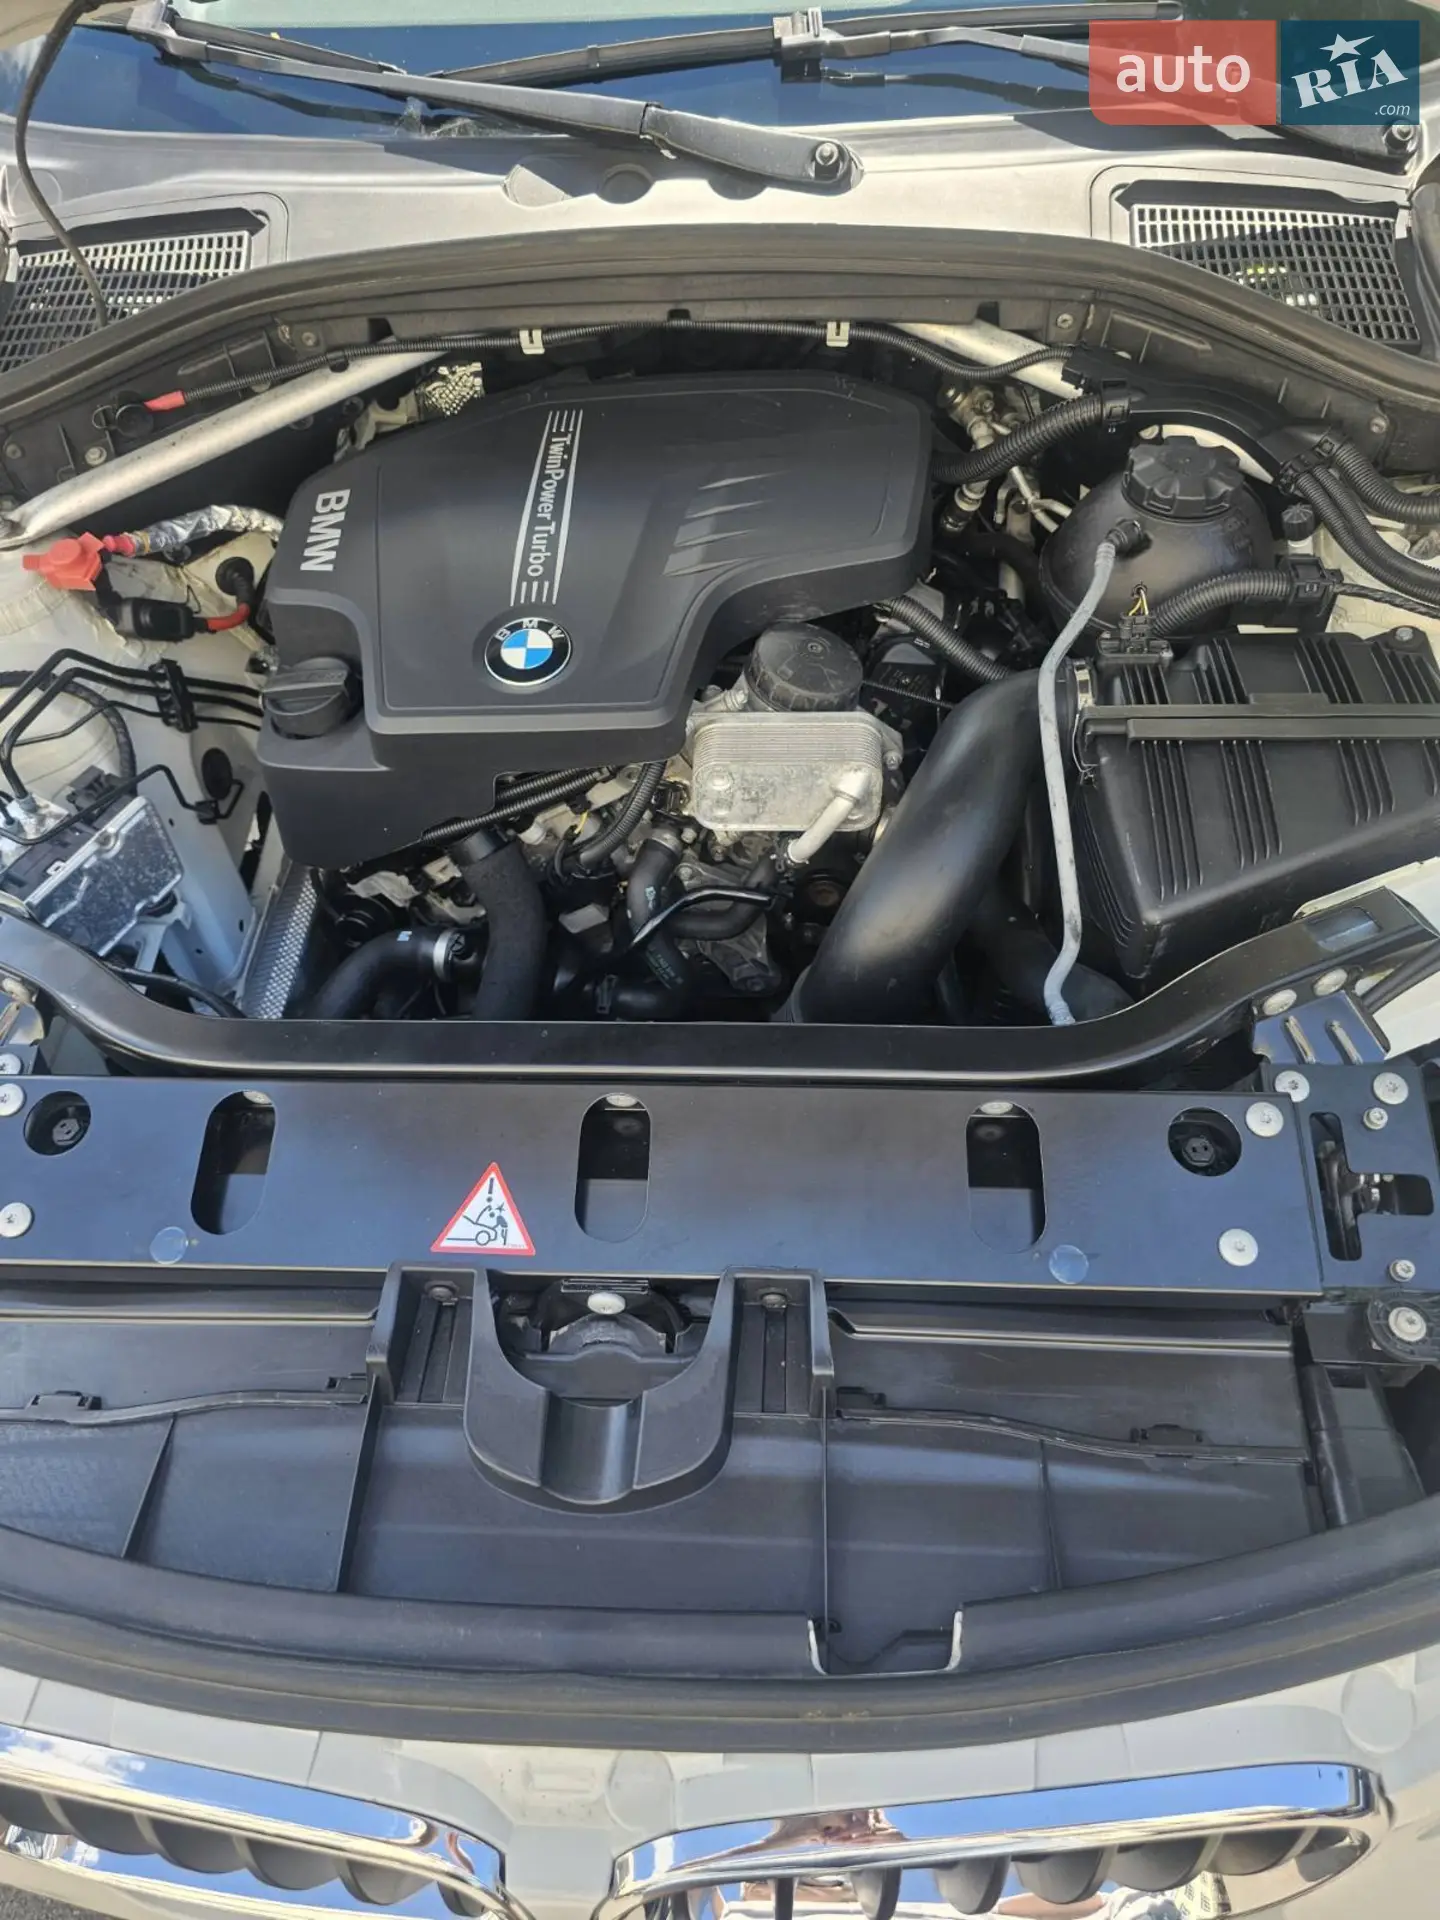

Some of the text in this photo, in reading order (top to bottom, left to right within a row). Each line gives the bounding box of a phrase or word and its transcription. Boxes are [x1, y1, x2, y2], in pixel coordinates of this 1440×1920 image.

[300, 489, 351, 572] BMW
[527, 433, 571, 577] TwinPower Turbo
[494, 618, 565, 642] BMW
